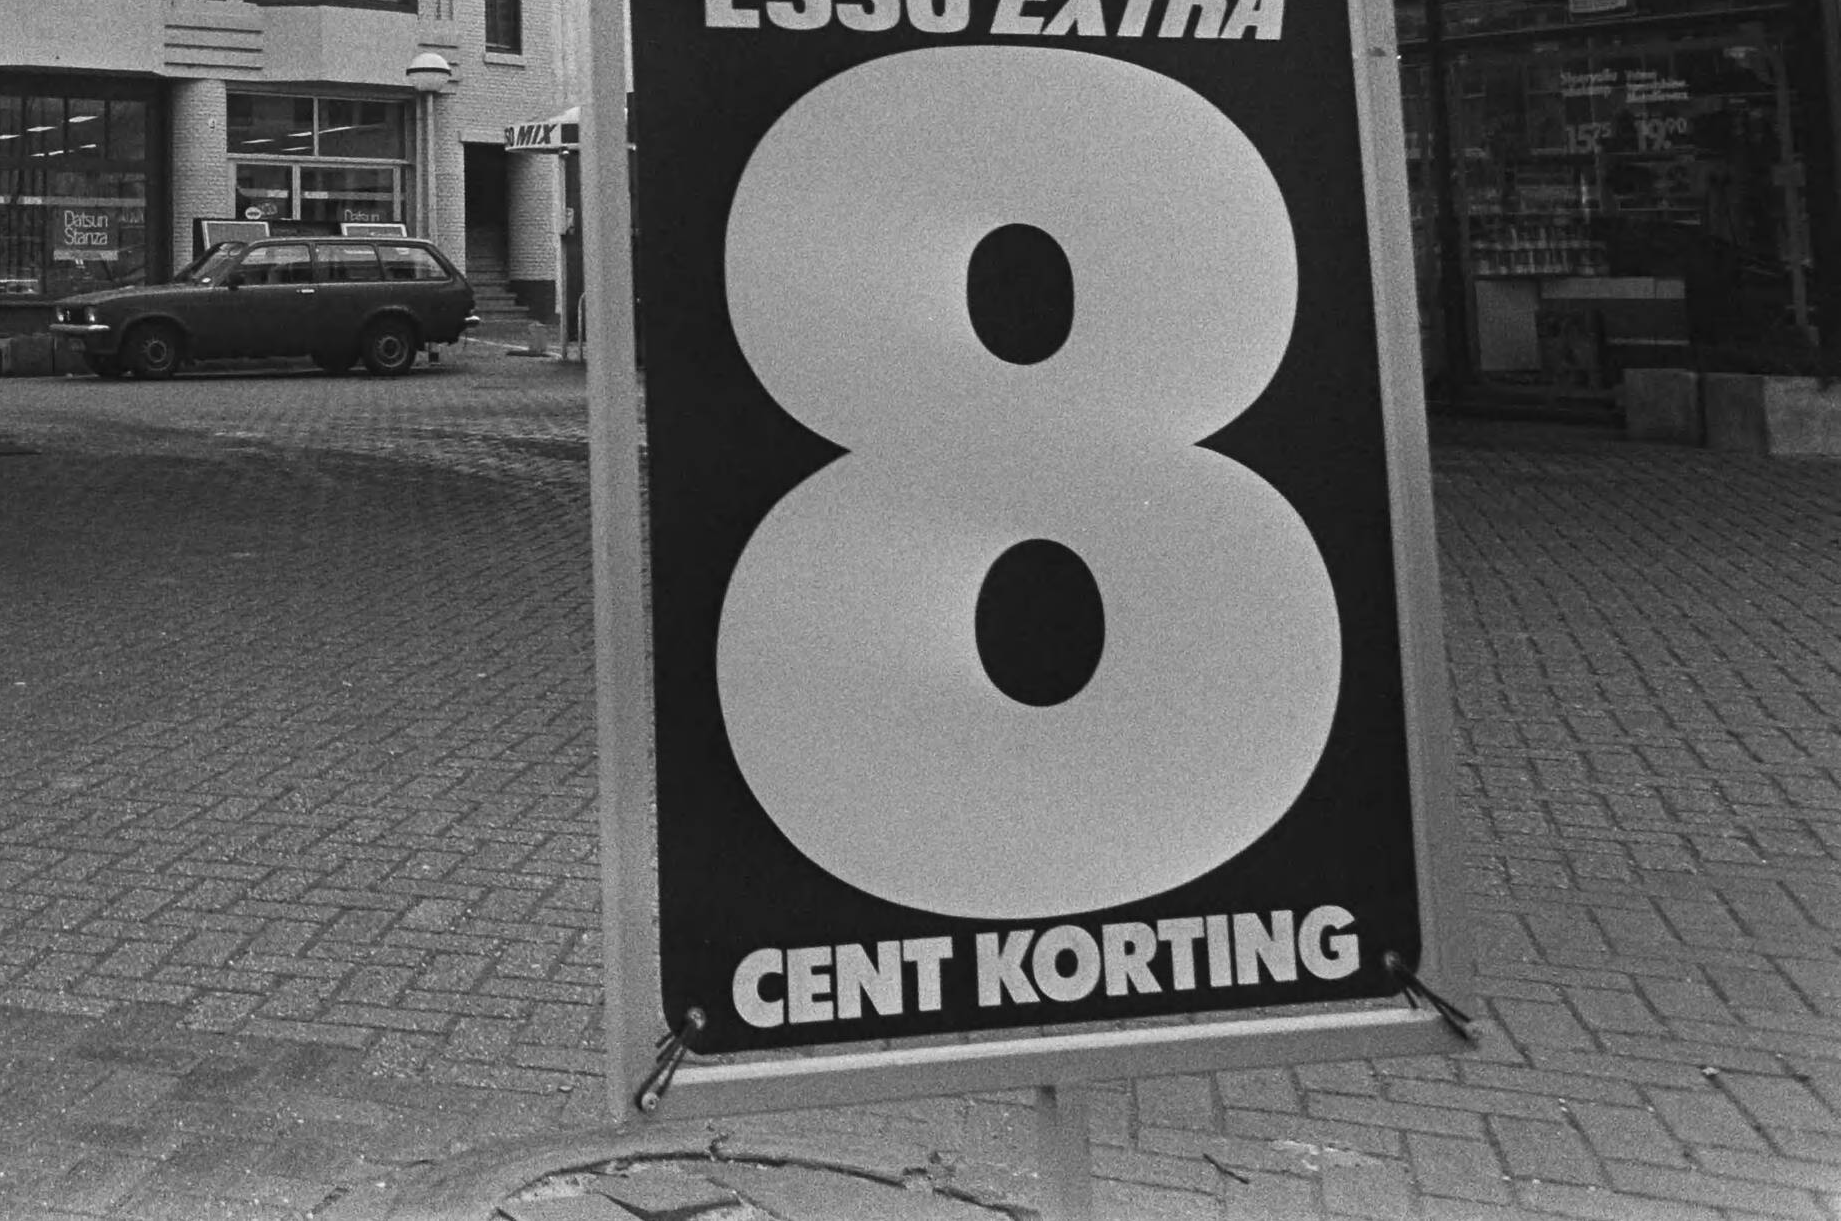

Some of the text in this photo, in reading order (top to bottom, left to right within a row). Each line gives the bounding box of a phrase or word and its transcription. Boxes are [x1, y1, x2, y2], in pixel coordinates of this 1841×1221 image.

[516, 123, 558, 146] MIX
[63, 210, 109, 228] Datsun
[63, 227, 108, 246] Stanza
[715, 44, 1343, 920] 8
[731, 904, 1361, 1029] CENT KORTING
